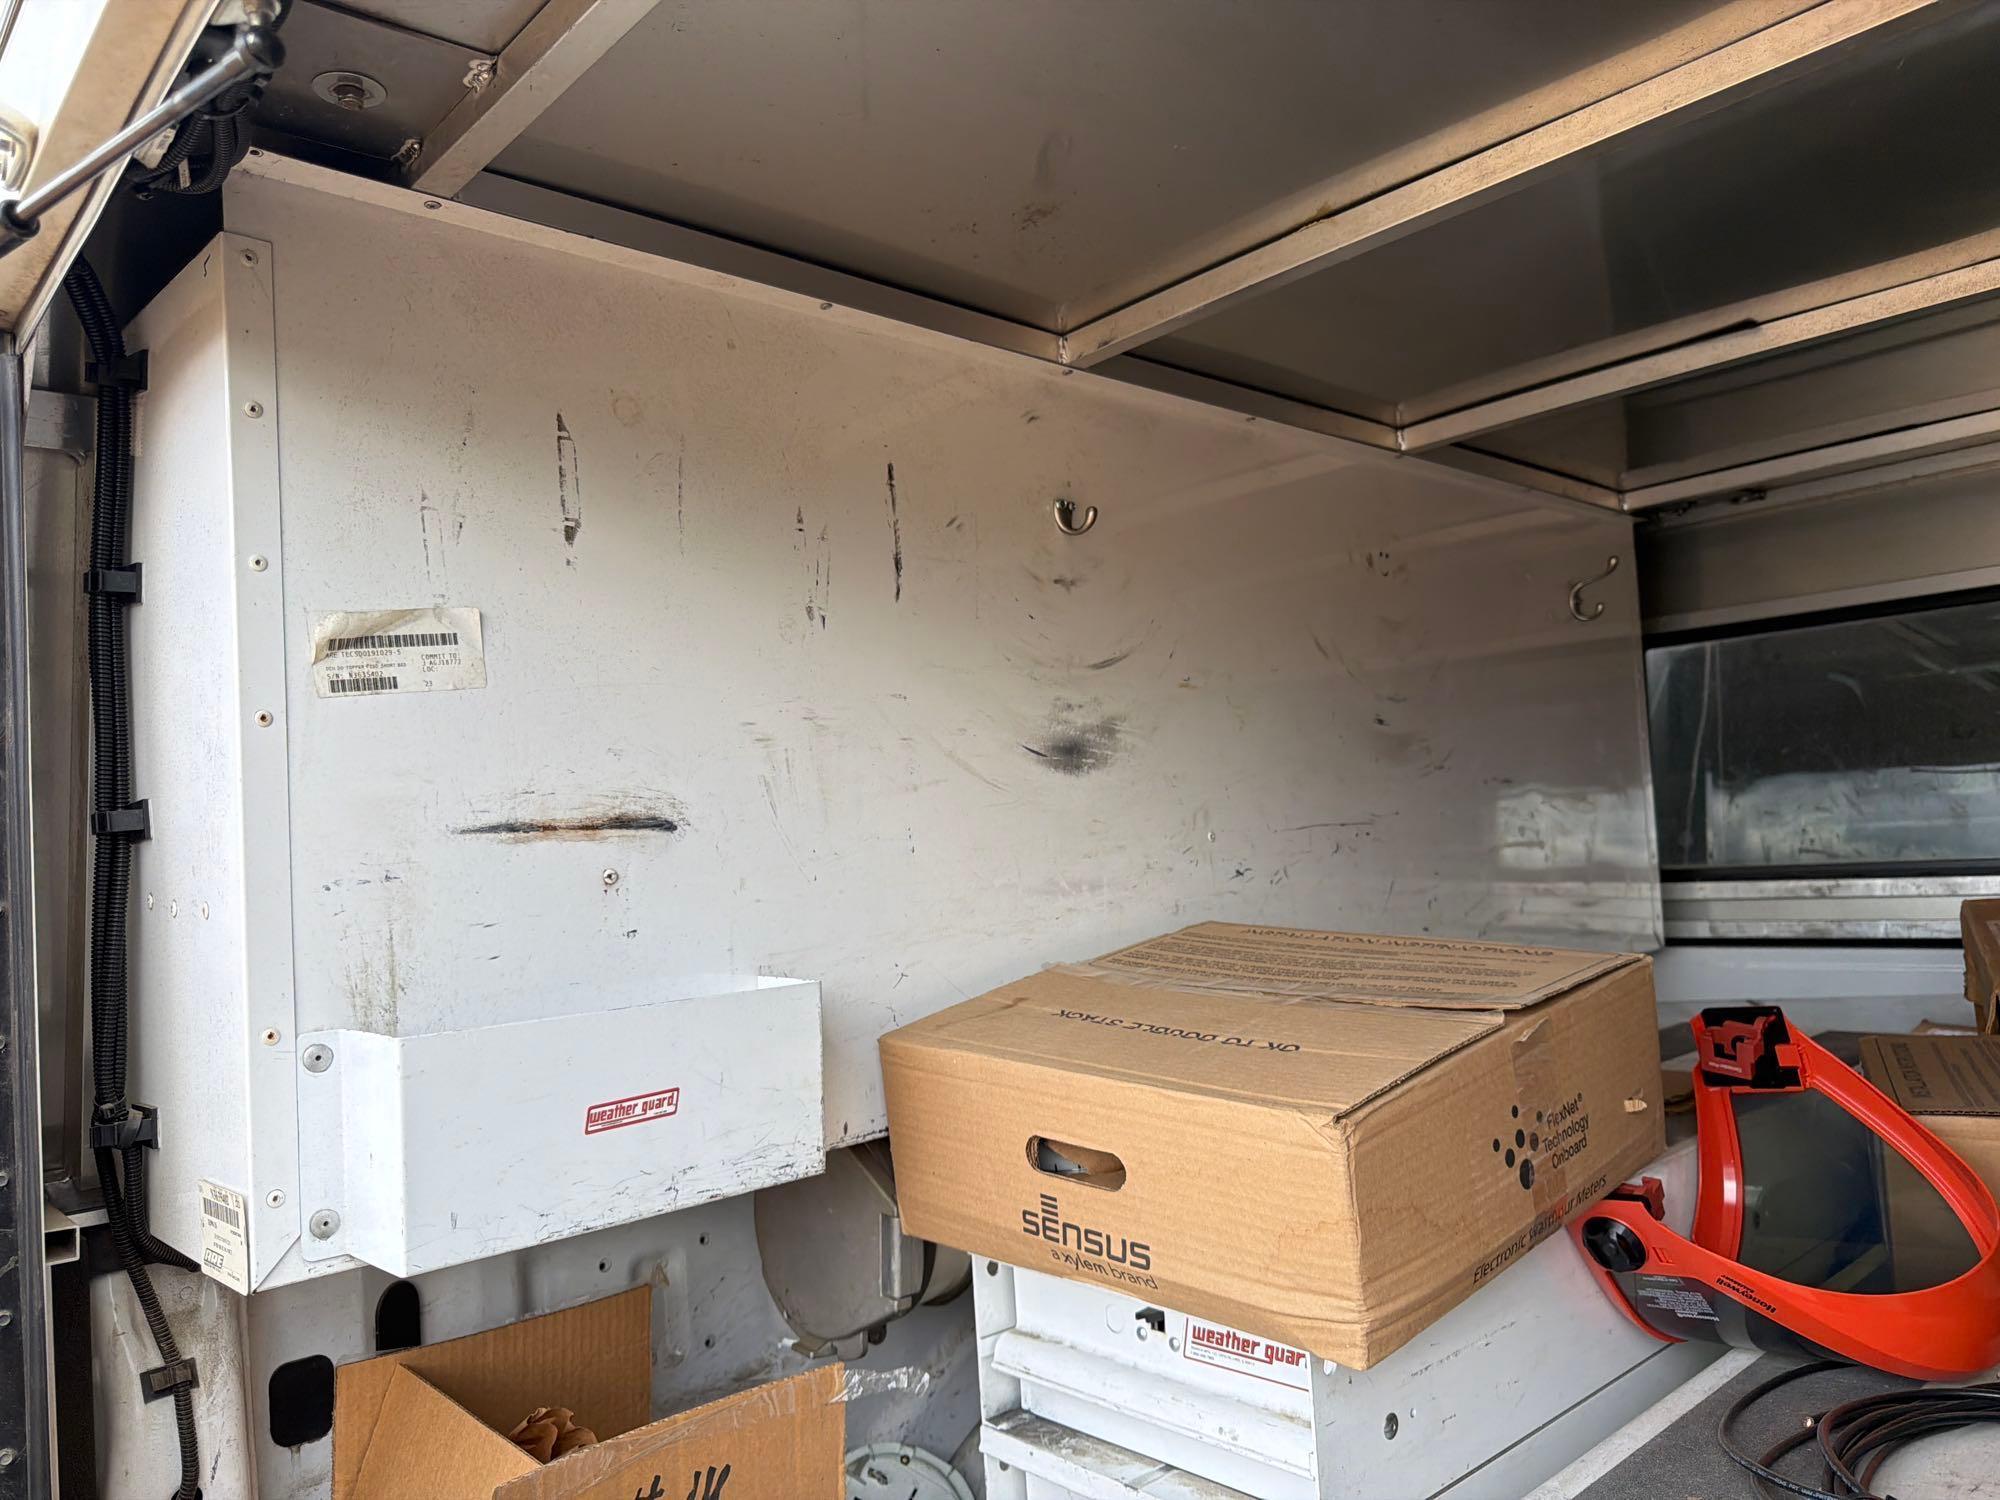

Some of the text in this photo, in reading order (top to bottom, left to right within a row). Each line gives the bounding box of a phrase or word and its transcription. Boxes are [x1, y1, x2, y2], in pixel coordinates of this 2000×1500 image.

[1051, 1008, 1301, 1052] OK TO DOUBLE STACK
[589, 1092, 675, 1124] weather guard
[1542, 1113, 1589, 1153] Technology
[1552, 1133, 1588, 1169] Onboard
[1473, 1233, 1527, 1285] Electronic
[1575, 1174, 1607, 1207] Meters
[1051, 1249, 1159, 1290] a xylem brand
[1716, 1277, 1777, 1314] Honeywell
[1192, 1324, 1260, 1355] weather
[1264, 1343, 1307, 1368] guar
